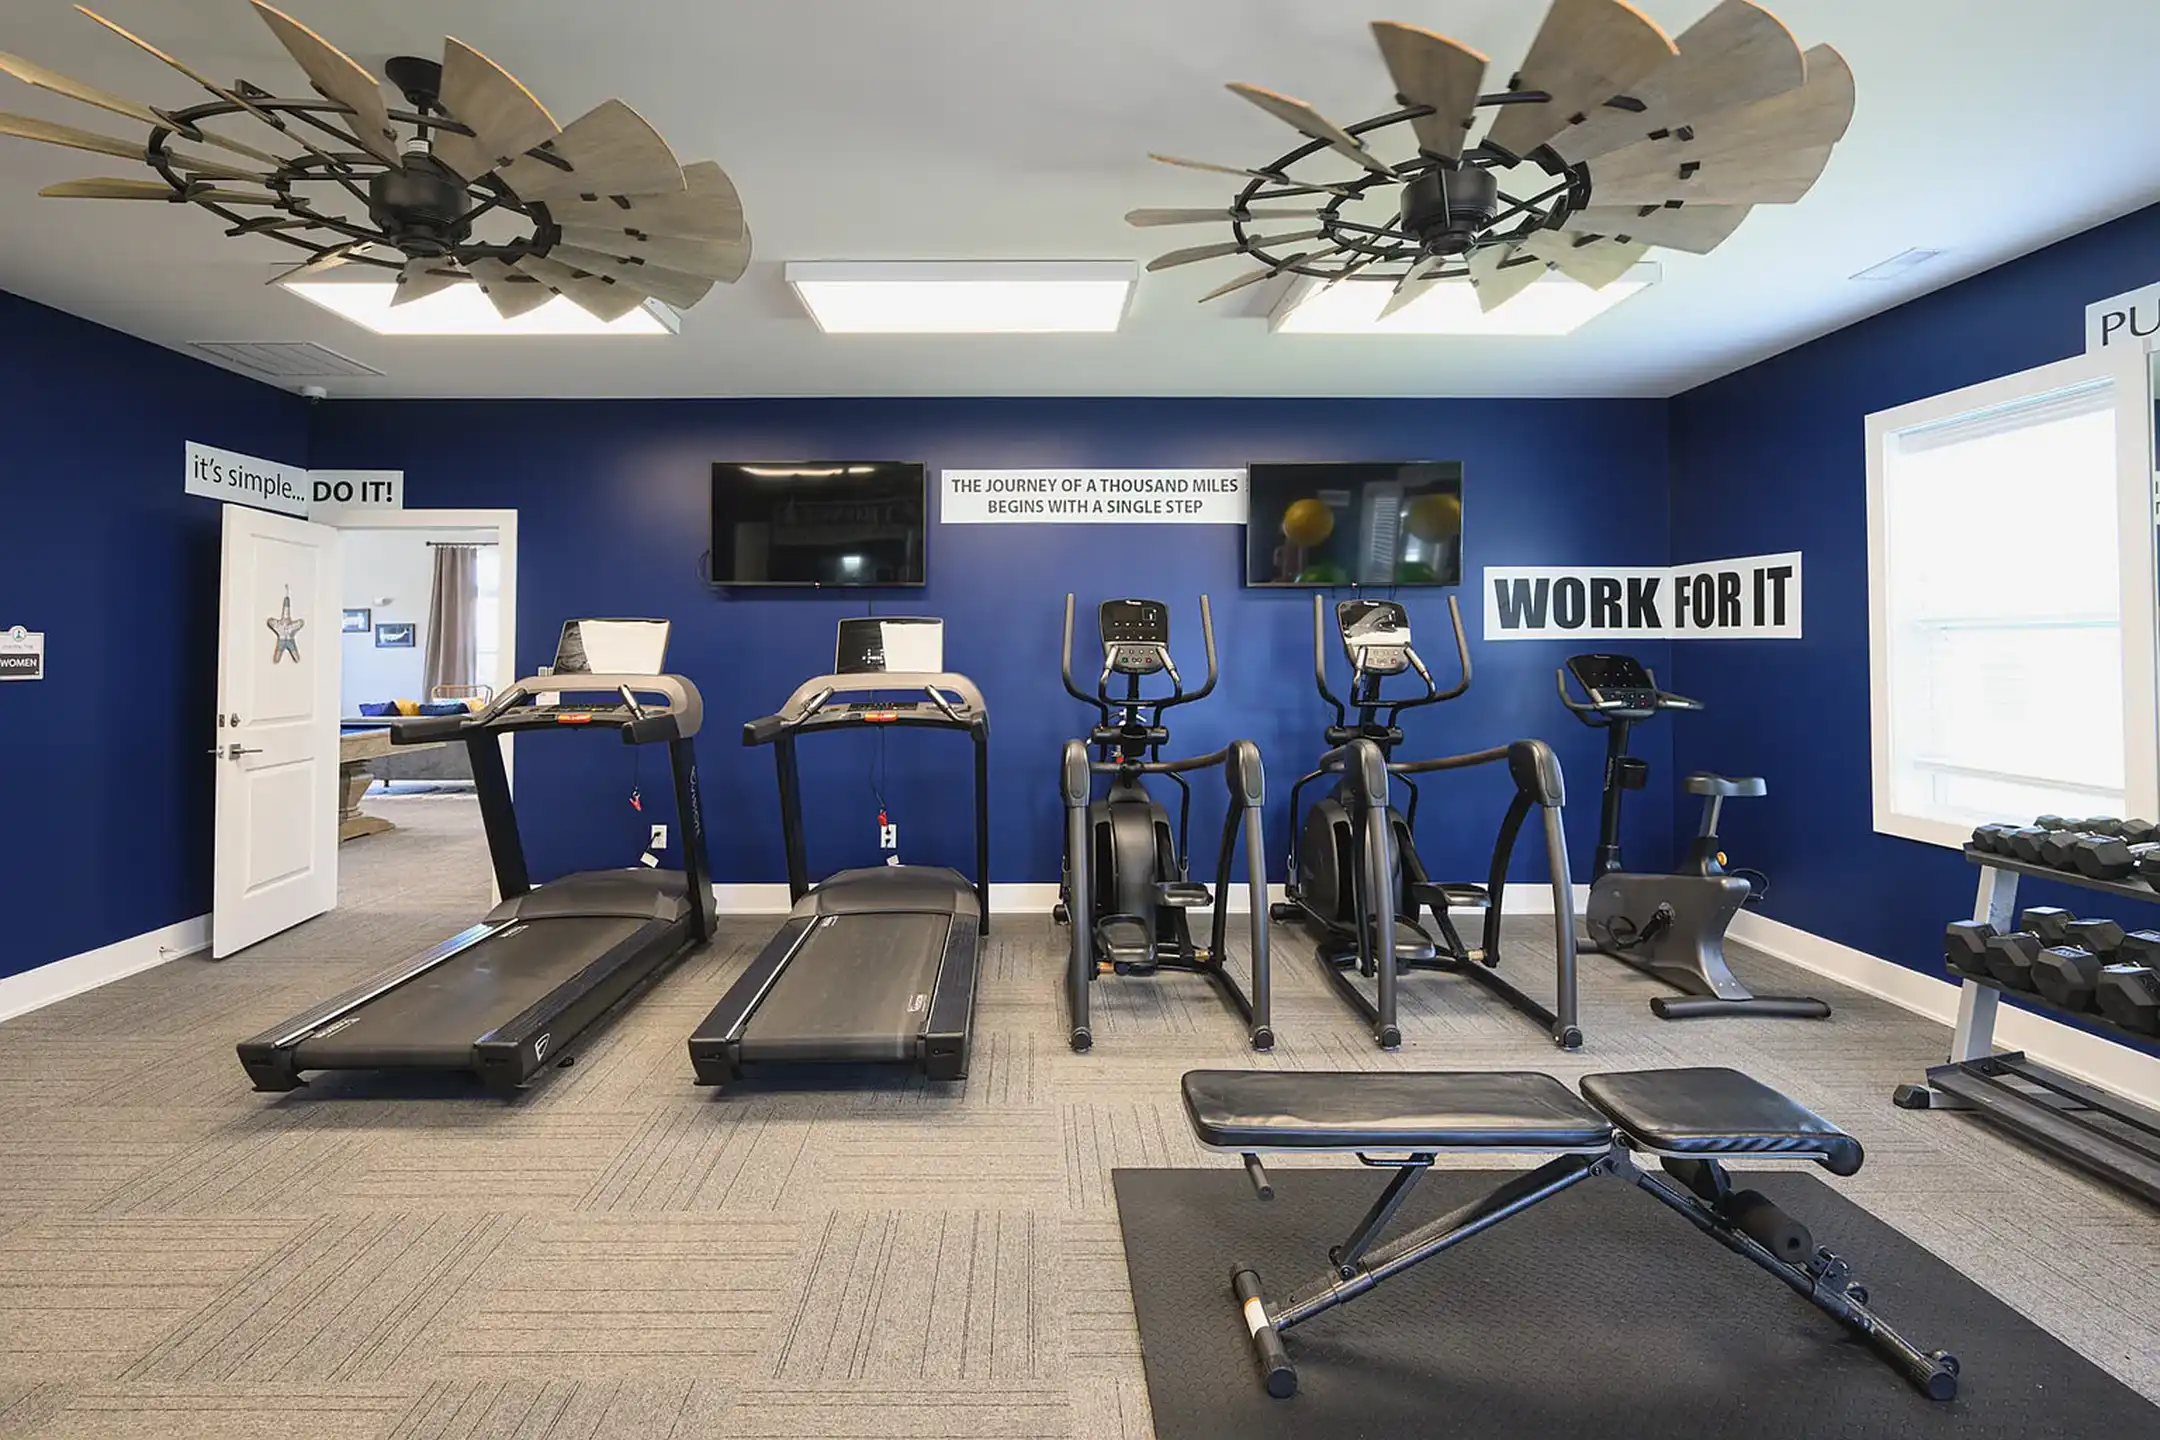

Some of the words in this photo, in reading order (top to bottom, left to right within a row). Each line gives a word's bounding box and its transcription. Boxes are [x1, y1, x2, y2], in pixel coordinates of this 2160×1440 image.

[194, 454, 223, 484] it's
[228, 465, 305, 502] simple...
[312, 481, 354, 503] DO
[362, 481, 393, 503] IT!
[951, 478, 982, 493] THE
[985, 478, 1057, 494] JOURNEY
[1061, 478, 1083, 493] OF
[1086, 478, 1096, 493] A
[1101, 478, 1189, 493] THOUSAND
[1192, 478, 1239, 493] MILES
[988, 500, 1045, 514] BEGINS
[1048, 500, 1088, 514] WITH
[1092, 500, 1103, 514] A
[1107, 499, 1162, 514] SINGLE
[1166, 500, 1204, 514] STEP
[1494, 576, 1662, 630] WORK
[1674, 571, 1742, 629] FOR
[1753, 565, 1793, 627] IT
